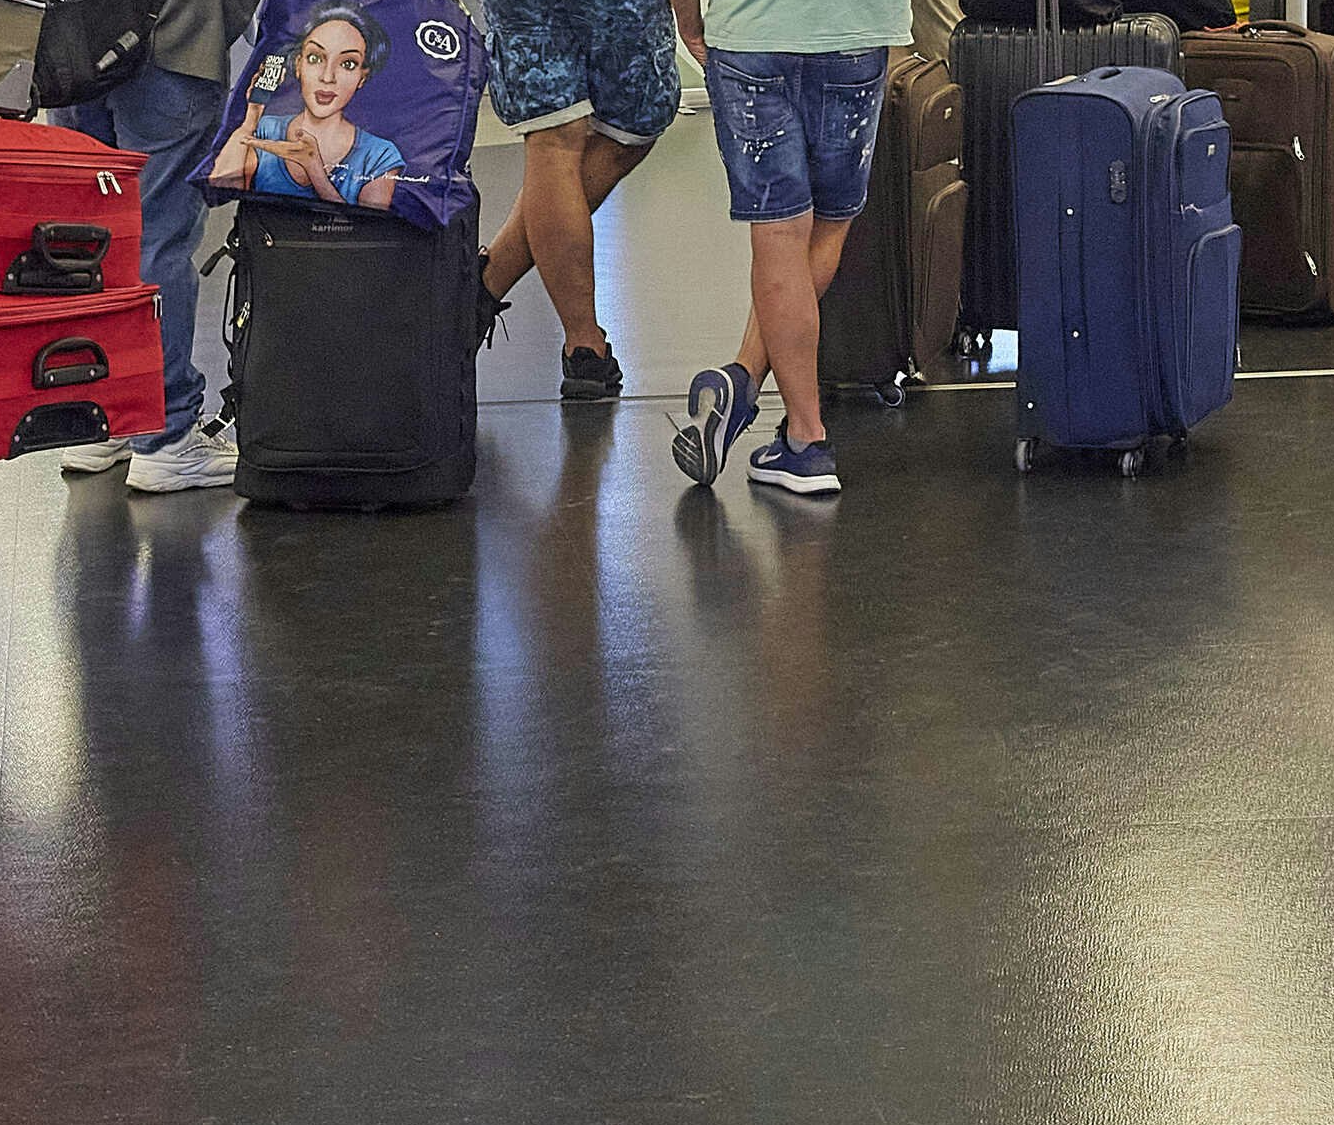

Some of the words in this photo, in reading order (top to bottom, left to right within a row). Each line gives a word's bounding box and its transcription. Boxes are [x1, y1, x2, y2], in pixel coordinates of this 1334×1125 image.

[424, 29, 453, 53] C&A
[265, 55, 285, 65] SHOP
[311, 223, 354, 233] karrimor
